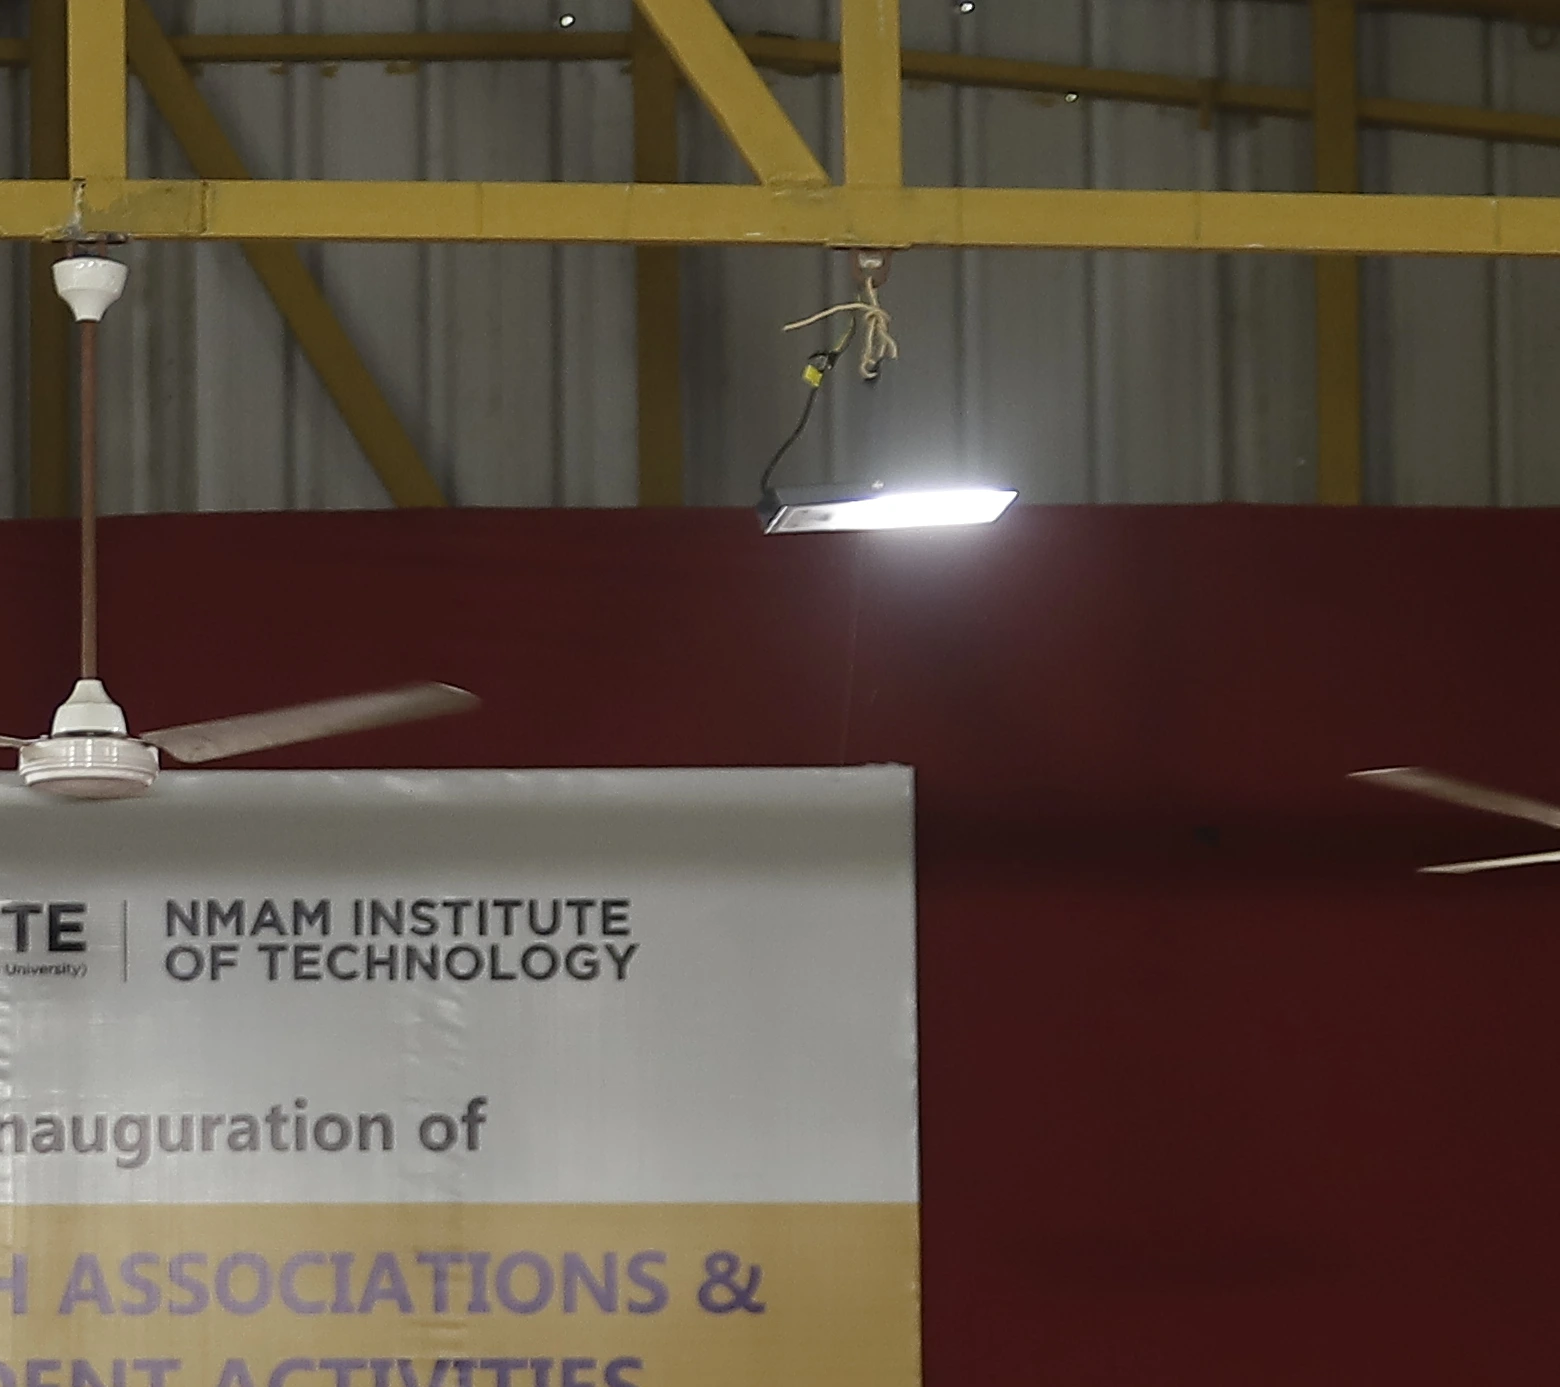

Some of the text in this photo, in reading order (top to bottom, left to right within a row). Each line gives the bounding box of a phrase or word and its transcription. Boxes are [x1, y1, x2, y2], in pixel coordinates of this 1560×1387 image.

[165, 899, 632, 937] NMAM INSTITUTE
[6, 962, 88, 978] University)
[164, 943, 641, 981] OF TECHNOLOGY
[418, 1096, 489, 1152] of
[57, 1250, 670, 1317] ASSOCIATIONS
[697, 1250, 767, 1315] &
